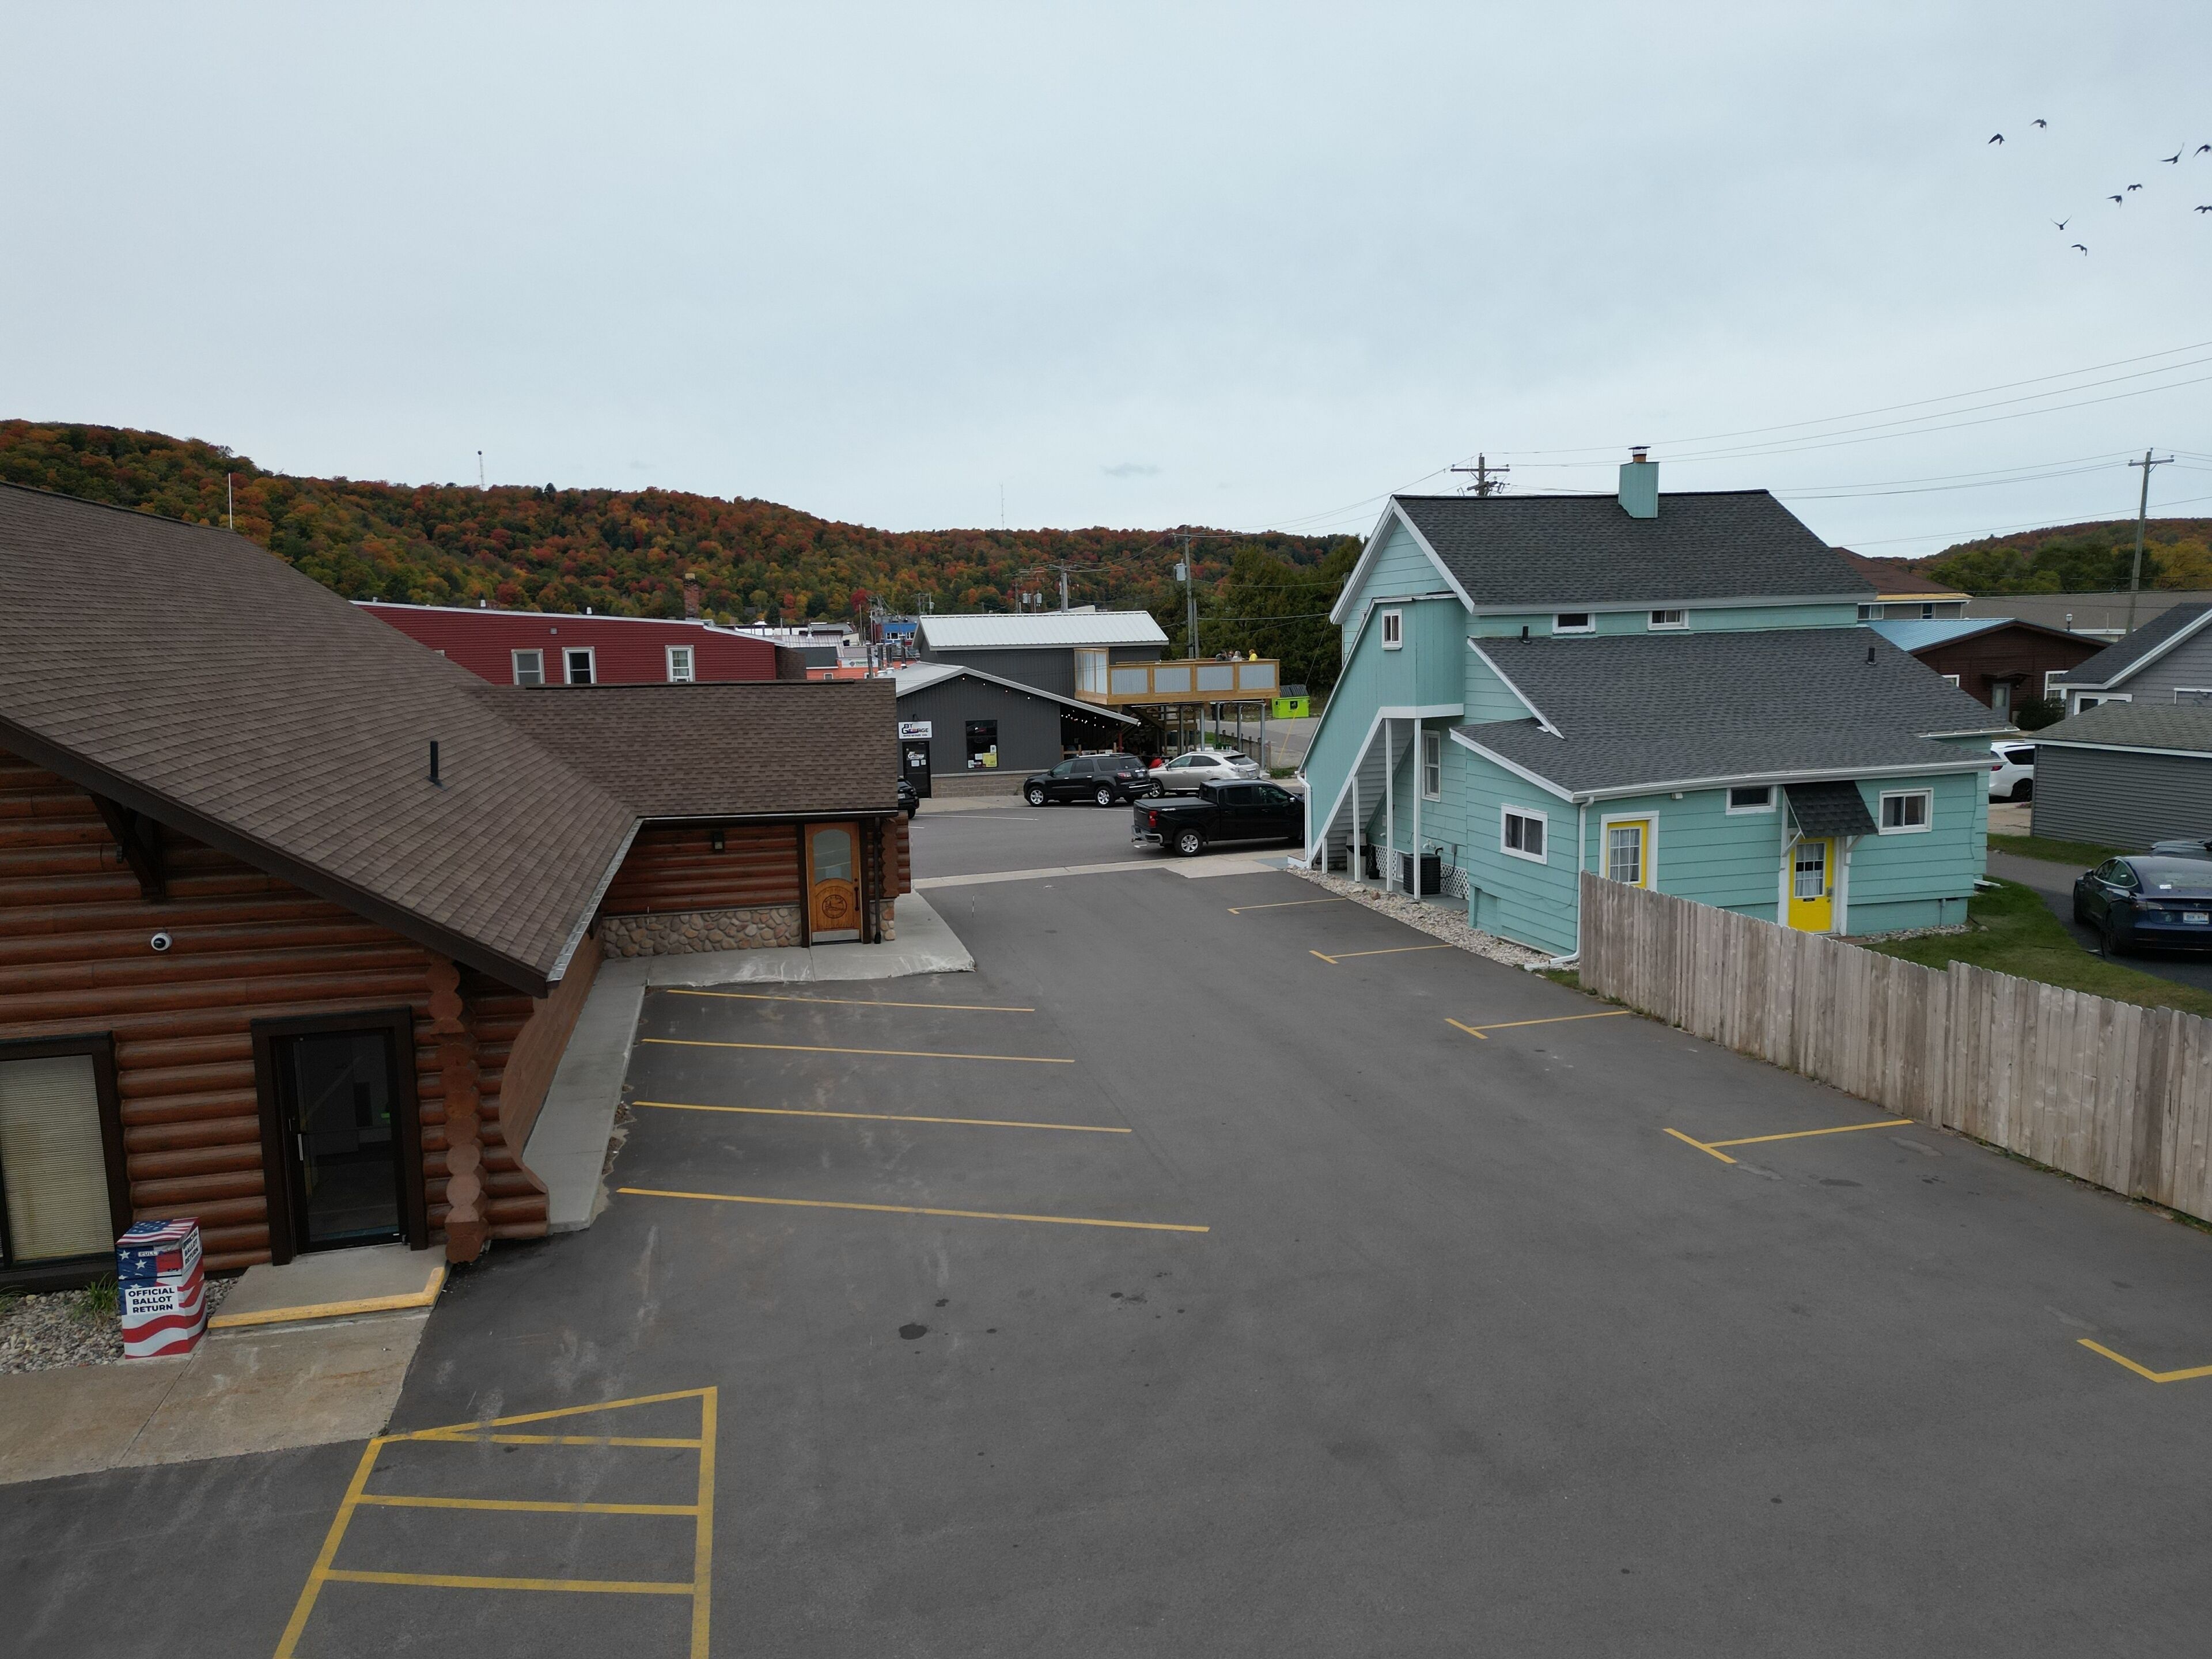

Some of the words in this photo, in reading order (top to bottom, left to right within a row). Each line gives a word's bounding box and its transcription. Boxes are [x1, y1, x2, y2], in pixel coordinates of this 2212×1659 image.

[184, 1238, 198, 1256] BALLOT
[185, 1246, 199, 1266] RETURN
[128, 1287, 175, 1297] OFFICIAL
[132, 1296, 172, 1305] BALLOT
[132, 1304, 173, 1313] RETURN
